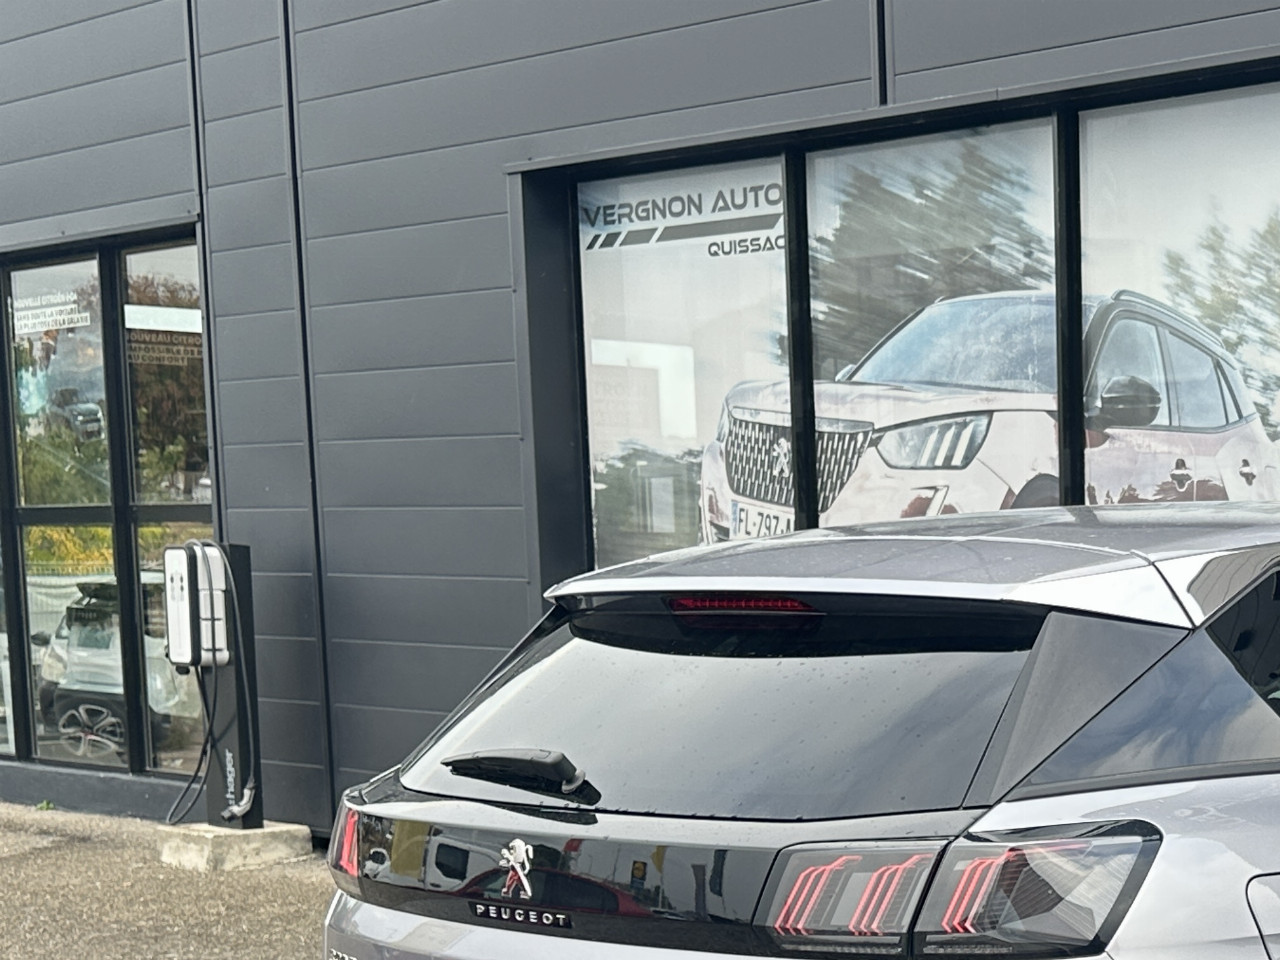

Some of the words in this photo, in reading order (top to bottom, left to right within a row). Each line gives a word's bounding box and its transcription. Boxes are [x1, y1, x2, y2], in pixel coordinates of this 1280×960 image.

[582, 192, 703, 228] VERGNON
[711, 183, 783, 213] AUTO
[708, 235, 786, 257] QUISSAC
[476, 904, 567, 927] PEUGEOT
